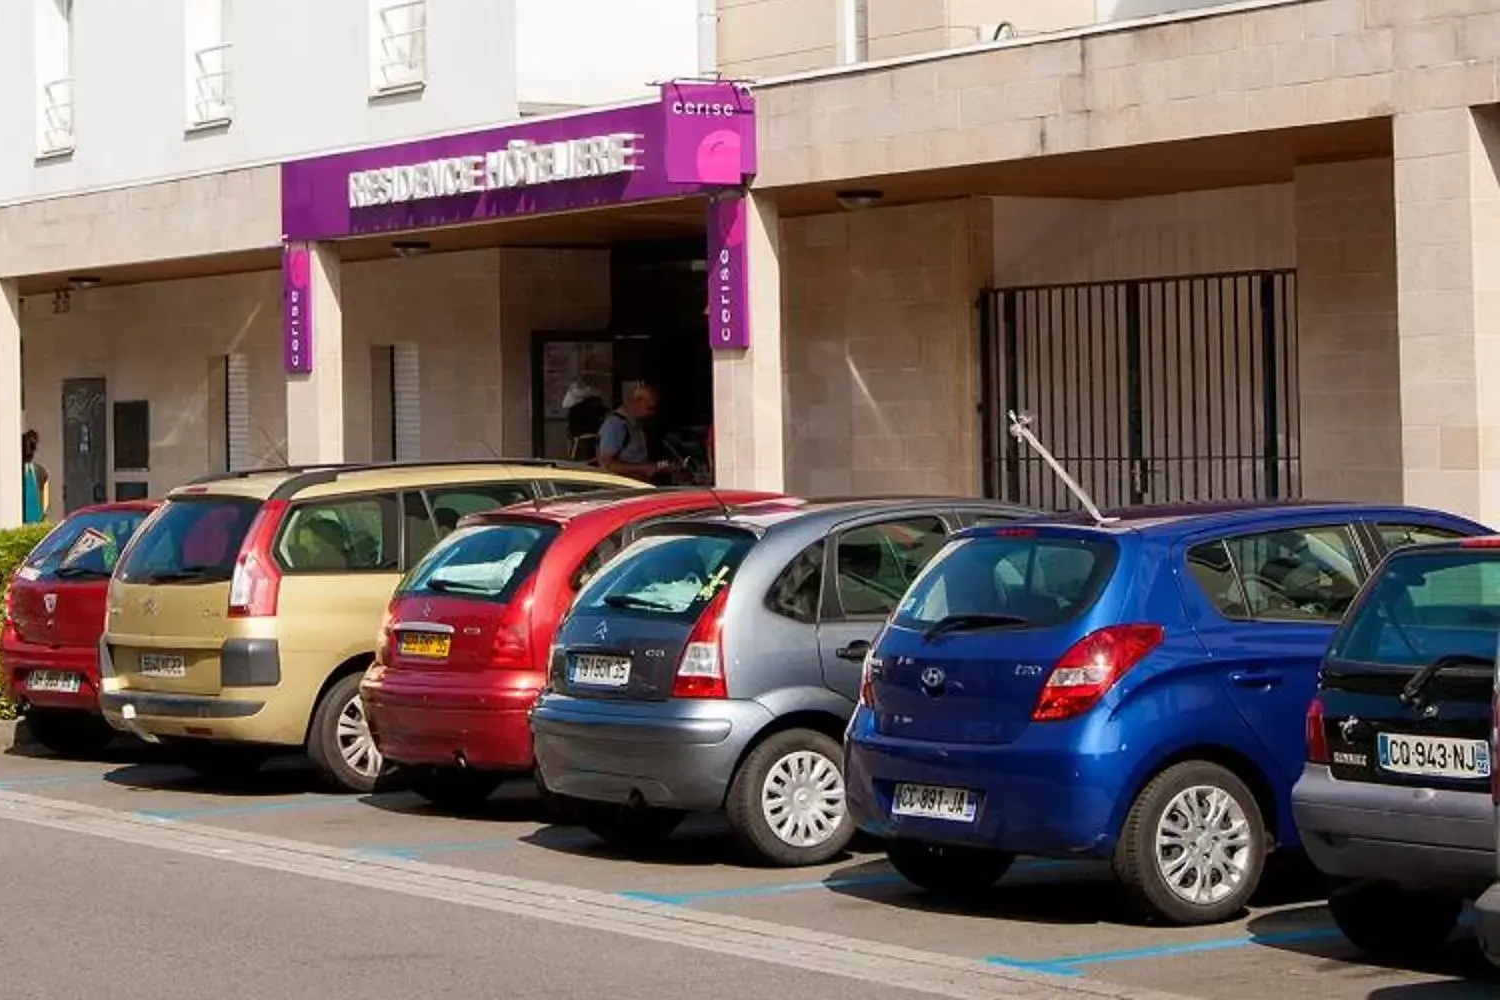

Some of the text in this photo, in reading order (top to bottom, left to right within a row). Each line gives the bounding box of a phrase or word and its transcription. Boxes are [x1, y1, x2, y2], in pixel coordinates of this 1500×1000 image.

[672, 101, 734, 118] cerise
[290, 290, 300, 367] cerise
[719, 249, 732, 342] cerise
